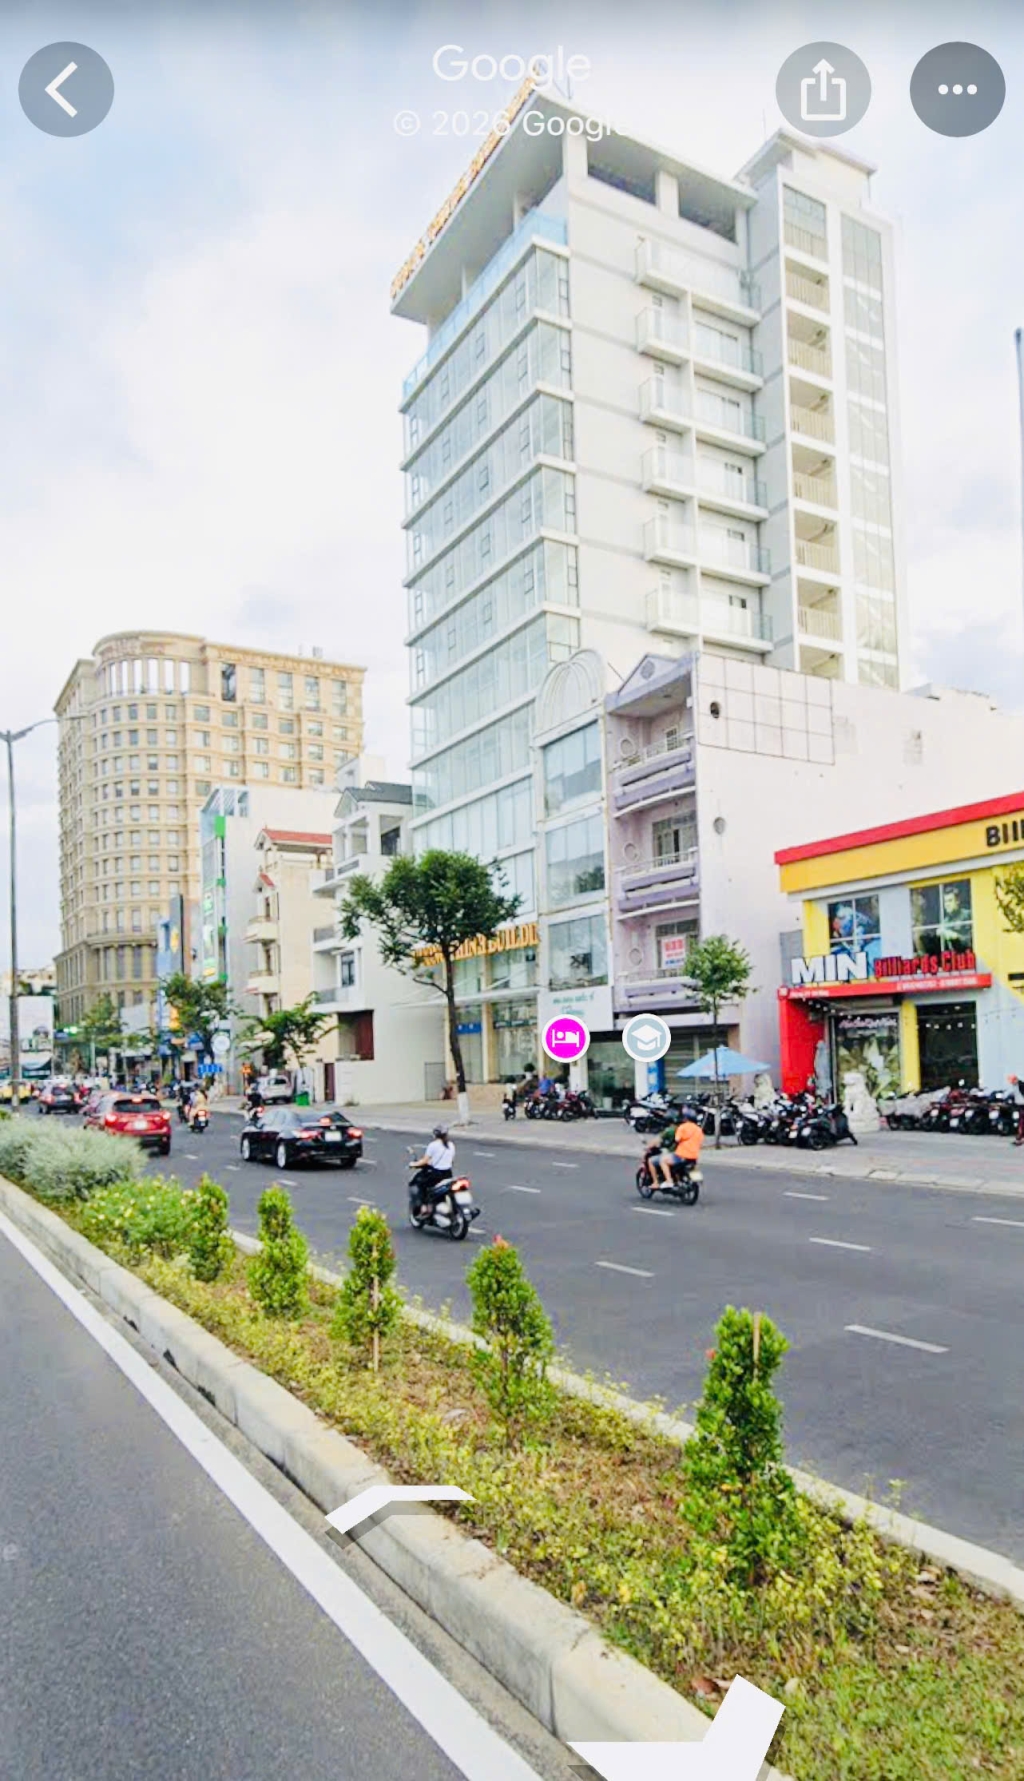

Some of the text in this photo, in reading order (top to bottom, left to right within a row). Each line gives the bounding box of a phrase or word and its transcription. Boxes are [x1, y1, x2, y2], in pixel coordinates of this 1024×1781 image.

[791, 952, 868, 984] MIN
[873, 953, 939, 978] Billiards
[941, 948, 977, 972] Club
